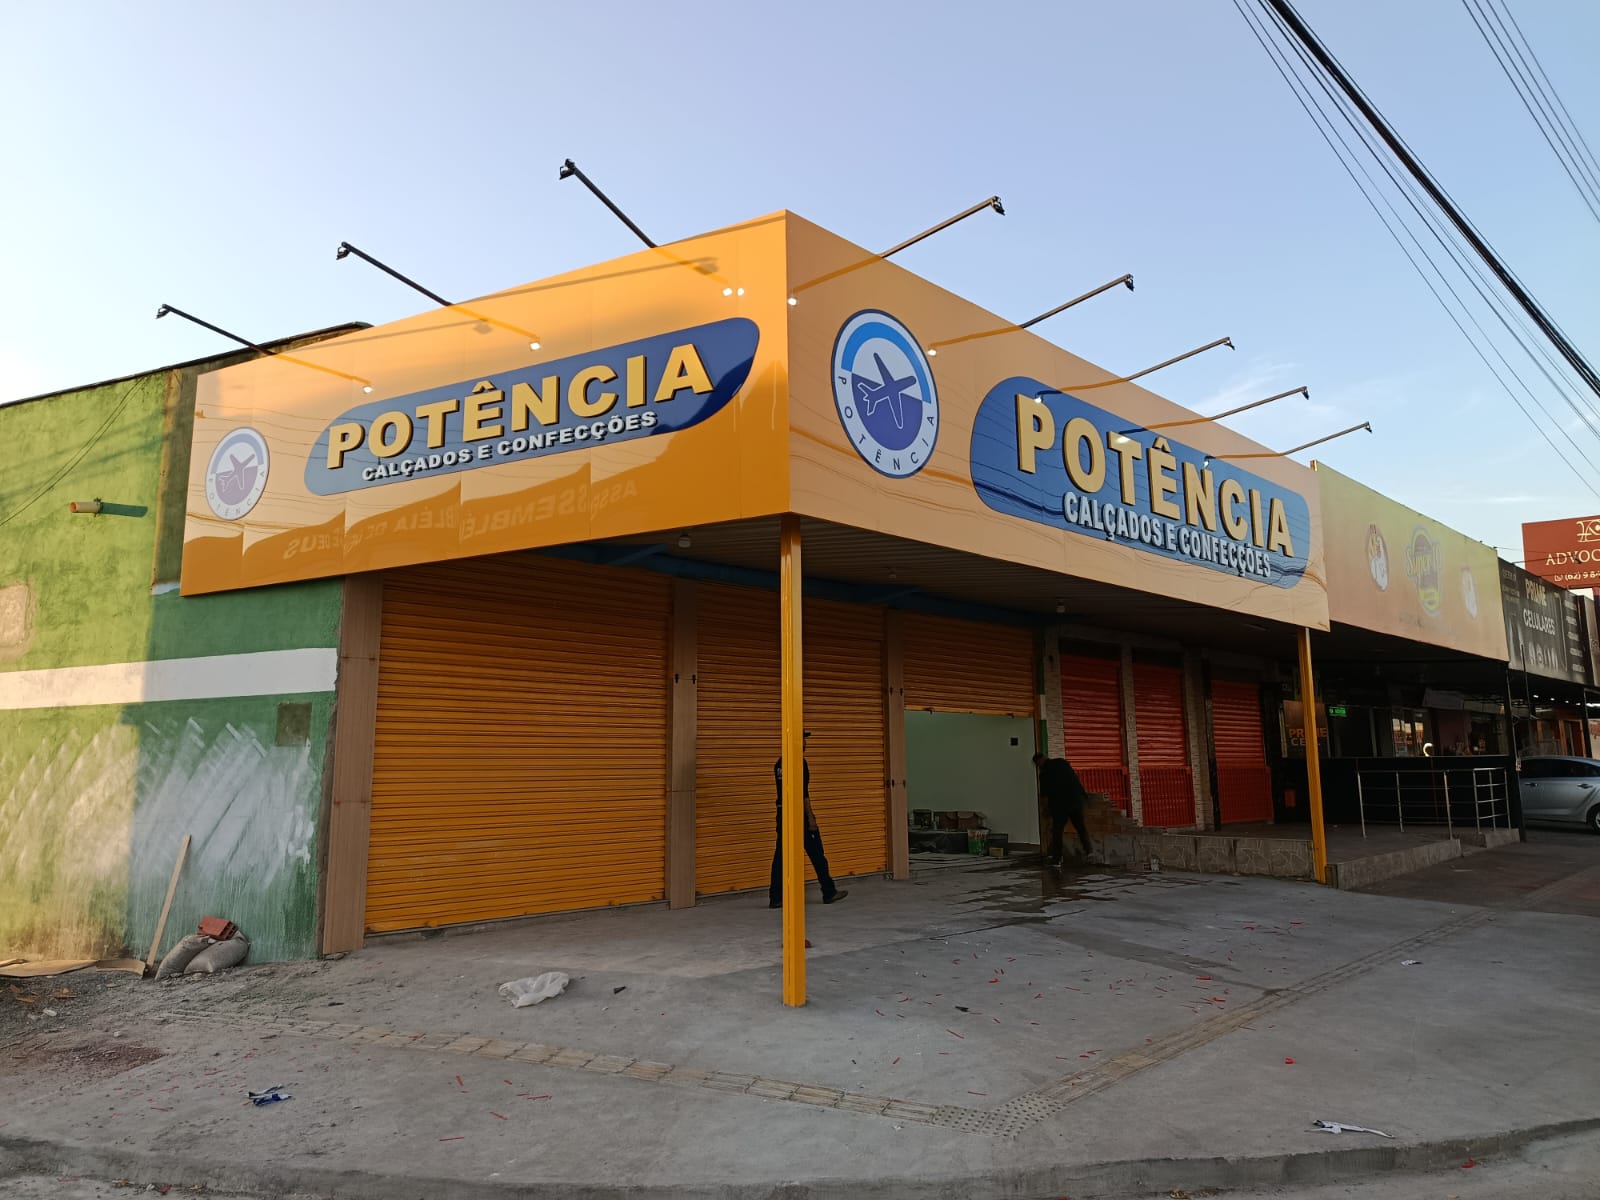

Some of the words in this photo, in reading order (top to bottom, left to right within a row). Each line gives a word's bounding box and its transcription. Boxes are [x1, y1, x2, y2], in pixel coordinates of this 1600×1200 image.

[326, 343, 714, 469] POTÊNCIA
[362, 447, 473, 482] CALÇADOS
[477, 444, 493, 460] E
[497, 411, 658, 456] CONFECÇÕES
[838, 375, 934, 471] POTÊNCIA
[1015, 393, 1295, 558] POTÊNCIA
[1063, 491, 1162, 547] CALÇADOS
[1163, 521, 1178, 551] E
[1178, 527, 1272, 577] CONFECÇÕES
[1288, 727, 1328, 738] PRE
